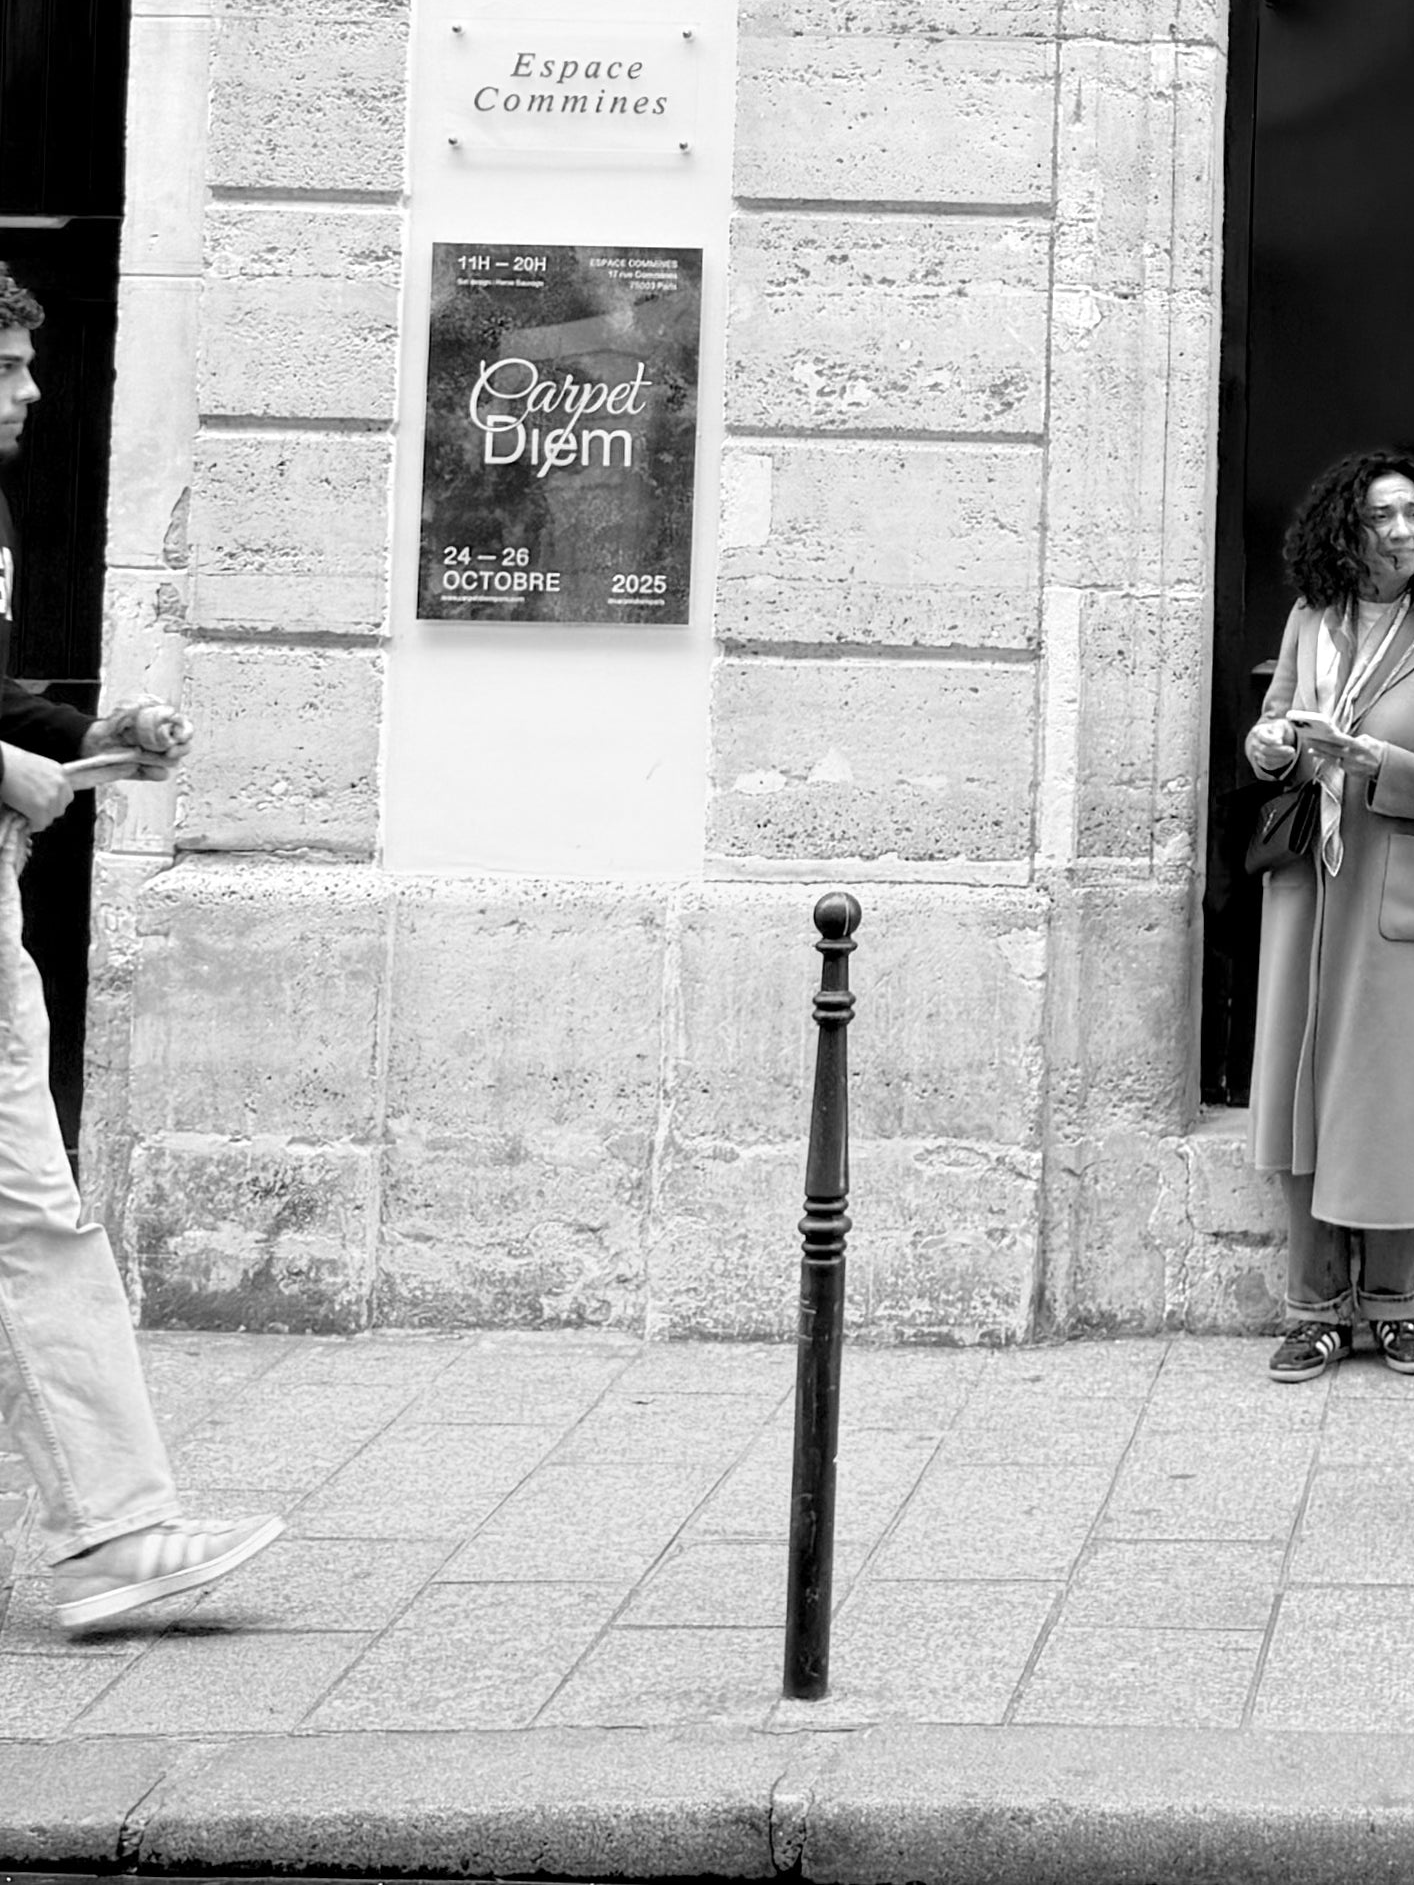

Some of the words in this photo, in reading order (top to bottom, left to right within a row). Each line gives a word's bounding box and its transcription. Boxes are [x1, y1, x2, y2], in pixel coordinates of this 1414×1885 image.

[510, 51, 644, 84] Espace
[473, 85, 669, 116] Commines
[457, 254, 491, 271] 11H
[512, 255, 547, 272] 20H
[469, 357, 653, 478] Carpet
[483, 414, 633, 467] Diem
[443, 546, 471, 566] 24
[501, 547, 530, 567] 26
[442, 570, 561, 592] OCTOBRE
[611, 574, 668, 594] 2025
